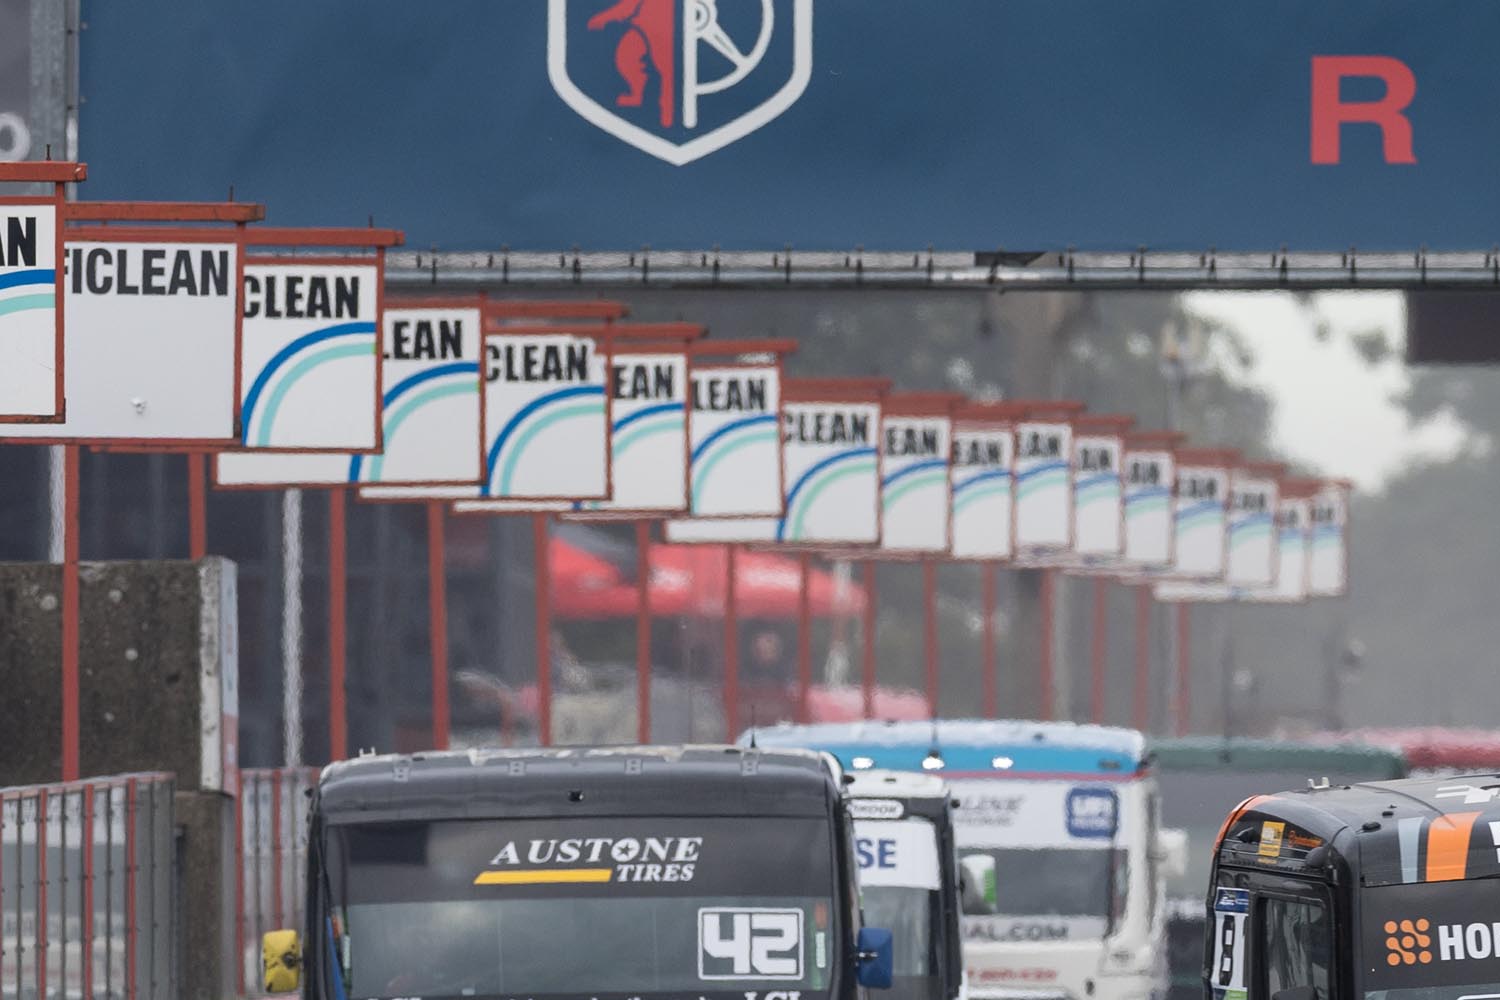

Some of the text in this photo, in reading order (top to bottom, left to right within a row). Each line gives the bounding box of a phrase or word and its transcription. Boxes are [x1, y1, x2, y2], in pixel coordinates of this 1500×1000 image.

[0, 217, 36, 266] N
[384, 320, 462, 359] EAN
[491, 837, 702, 865] AUSTONE
[617, 864, 695, 883] TIRES
[703, 913, 800, 975] 42
